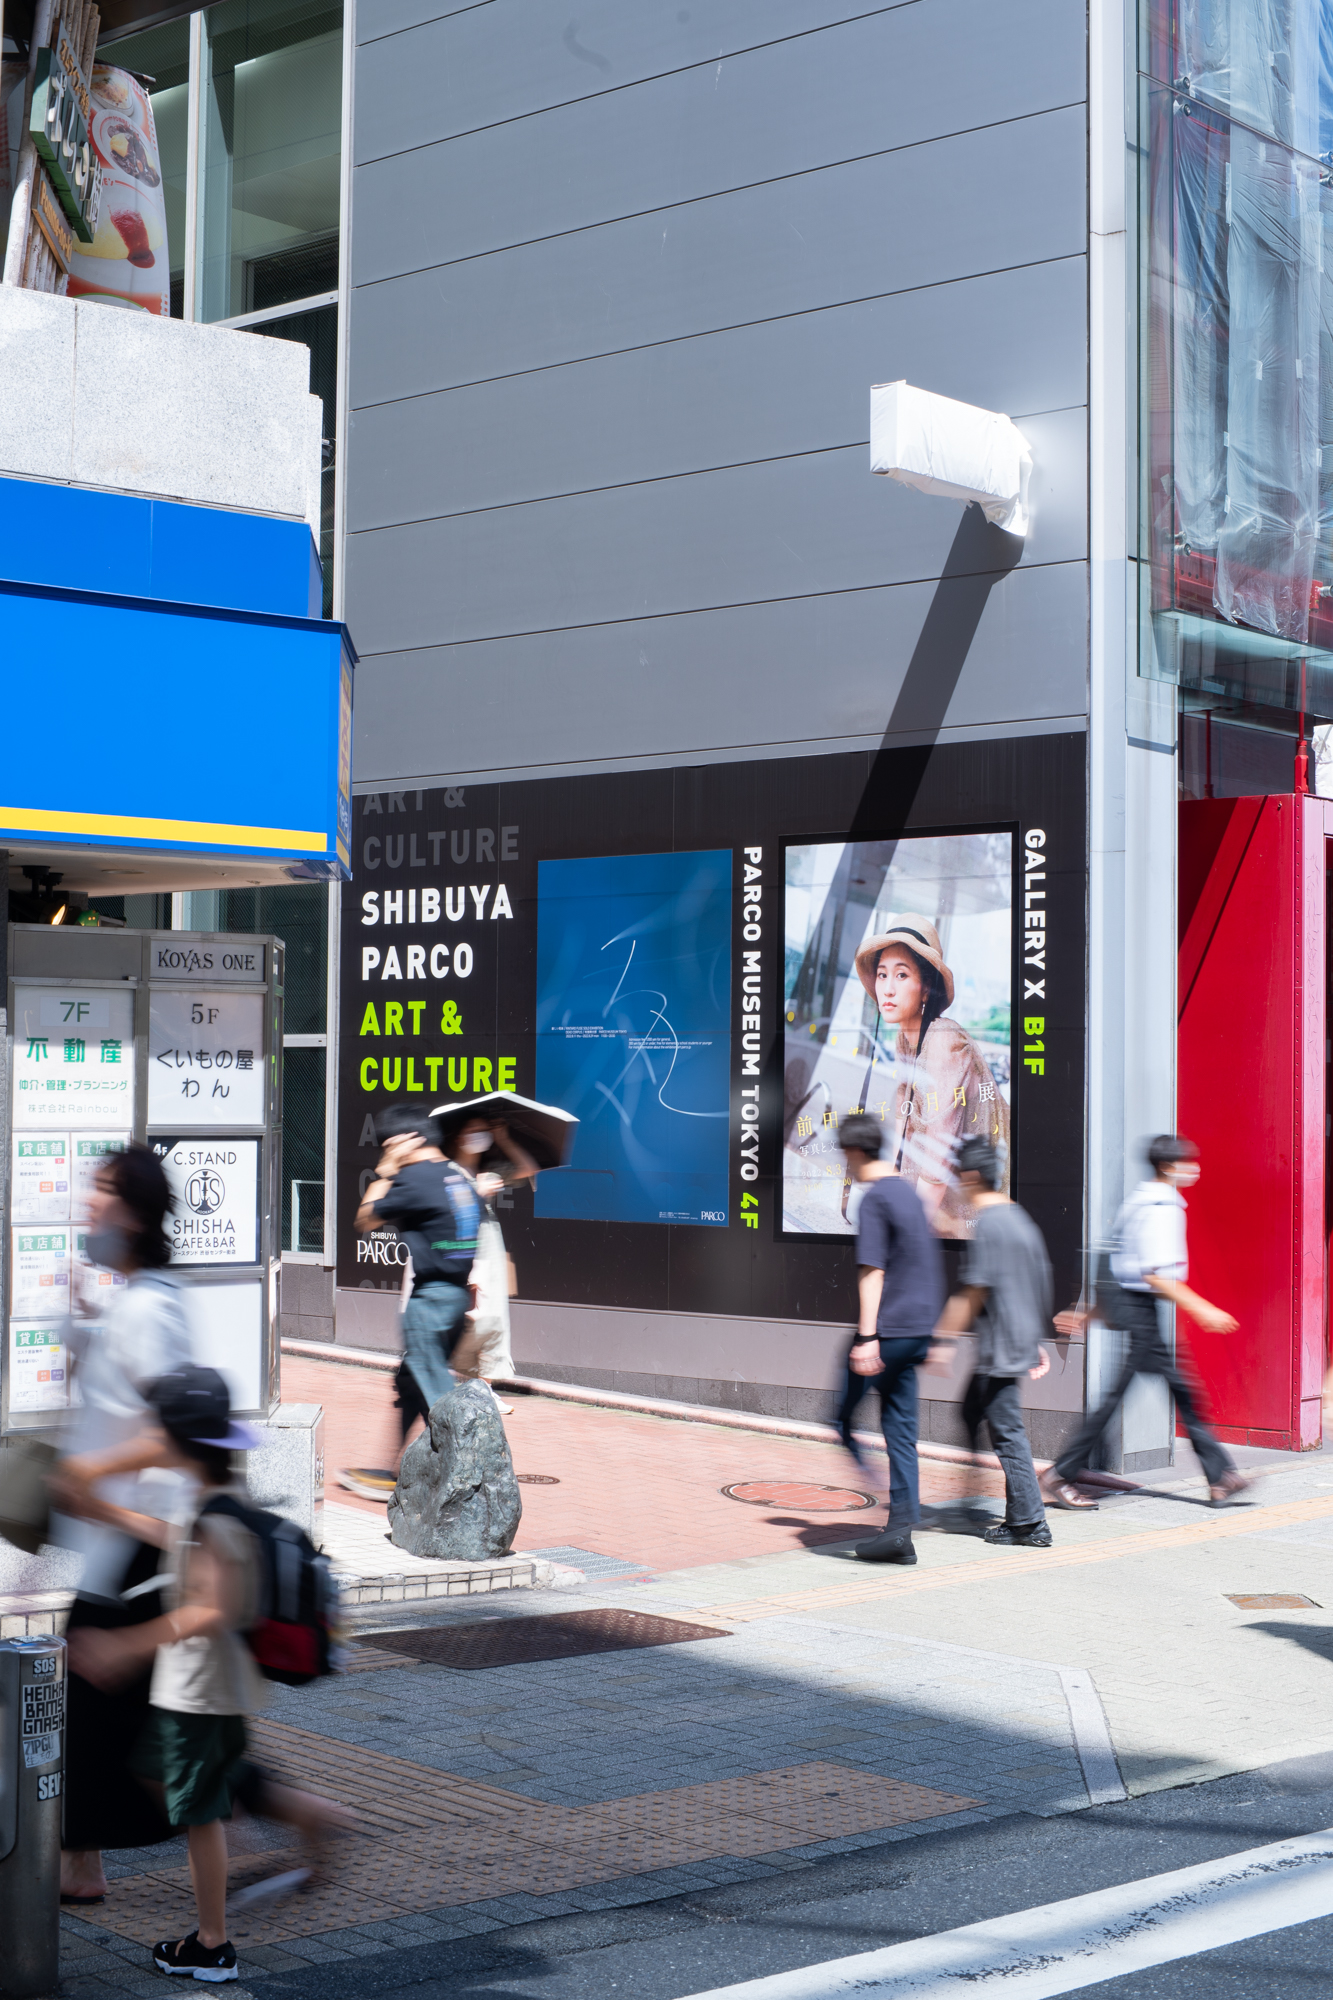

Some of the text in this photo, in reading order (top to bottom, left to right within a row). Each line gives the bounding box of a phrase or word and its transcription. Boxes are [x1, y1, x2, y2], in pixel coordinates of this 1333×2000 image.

[363, 826, 520, 870] CULTURE
[362, 883, 514, 926] SHIBUYA
[157, 948, 256, 973] KOYAS ONE
[362, 942, 474, 981] PARCO
[1023, 828, 1046, 1077] GALLERY X B1F
[59, 1001, 91, 1023] 7F
[191, 1003, 220, 1025] 5F
[360, 1000, 464, 1036] ART &
[740, 846, 763, 1229] PARCO MUSEUM TOKYO 4F
[26, 1037, 122, 1064] 不動産
[156, 1049, 255, 1071] くいもの屋
[360, 1055, 517, 1093] CULTURE
[18, 1079, 129, 1092] 仲介・管理・プランニング
[181, 1077, 231, 1099] わん
[27, 1103, 119, 1115] 株式会社Rainbow
[21, 1142, 63, 1156] 貸店舗
[153, 1143, 168, 1156] 4F
[173, 1152, 237, 1166] C.STAND
[799, 1139, 838, 1158] 写真と文
[172, 1218, 236, 1235] SHISHA
[701, 1211, 726, 1222] PARCO
[21, 1236, 64, 1251] 貸店舗
[370, 1231, 398, 1241] SHIBUYA
[356, 1240, 411, 1267] PARCO
[33, 1657, 56, 1674] SOS
[24, 1679, 65, 1702] HENKA
[38, 1771, 63, 1800] SEV
